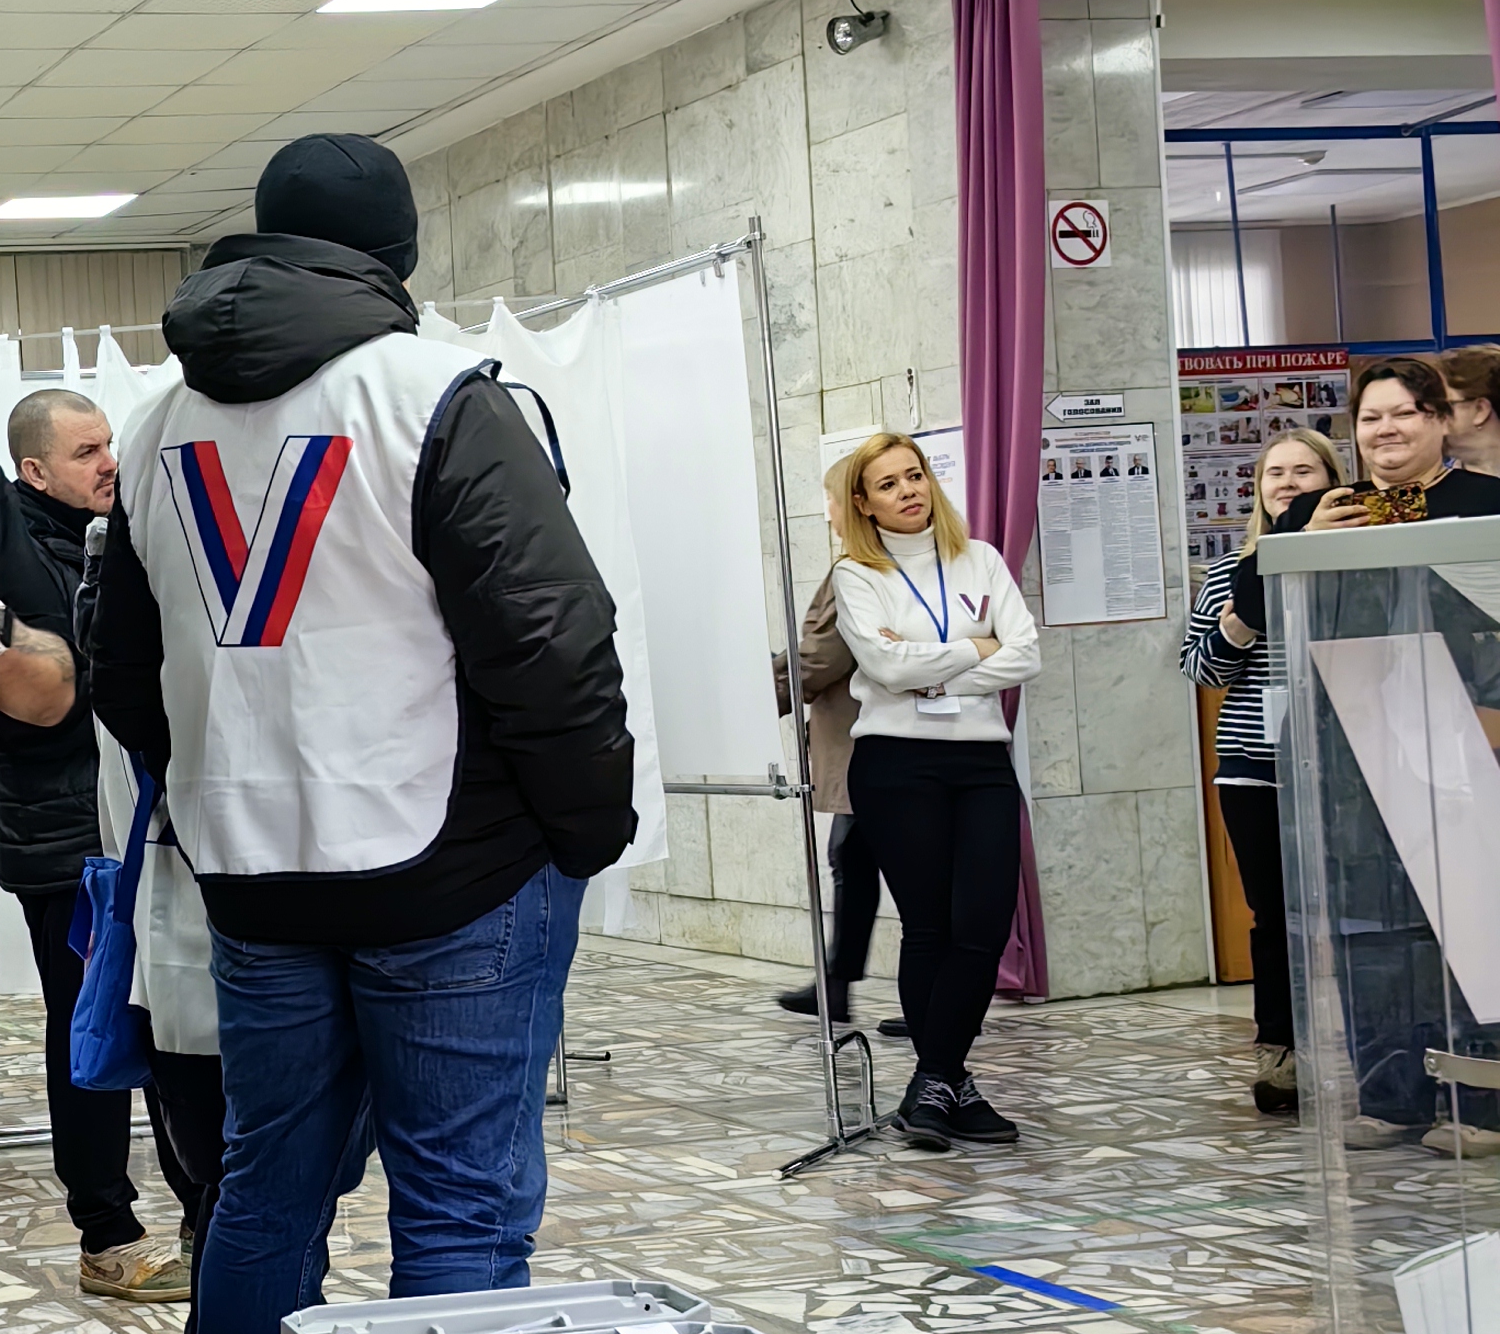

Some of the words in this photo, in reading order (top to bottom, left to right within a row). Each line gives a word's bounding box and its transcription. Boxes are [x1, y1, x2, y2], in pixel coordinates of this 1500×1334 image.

[1246, 354, 1276, 368] ПРИ
[1281, 351, 1346, 367] ПОЖАРЕ
[160, 435, 354, 648] V
